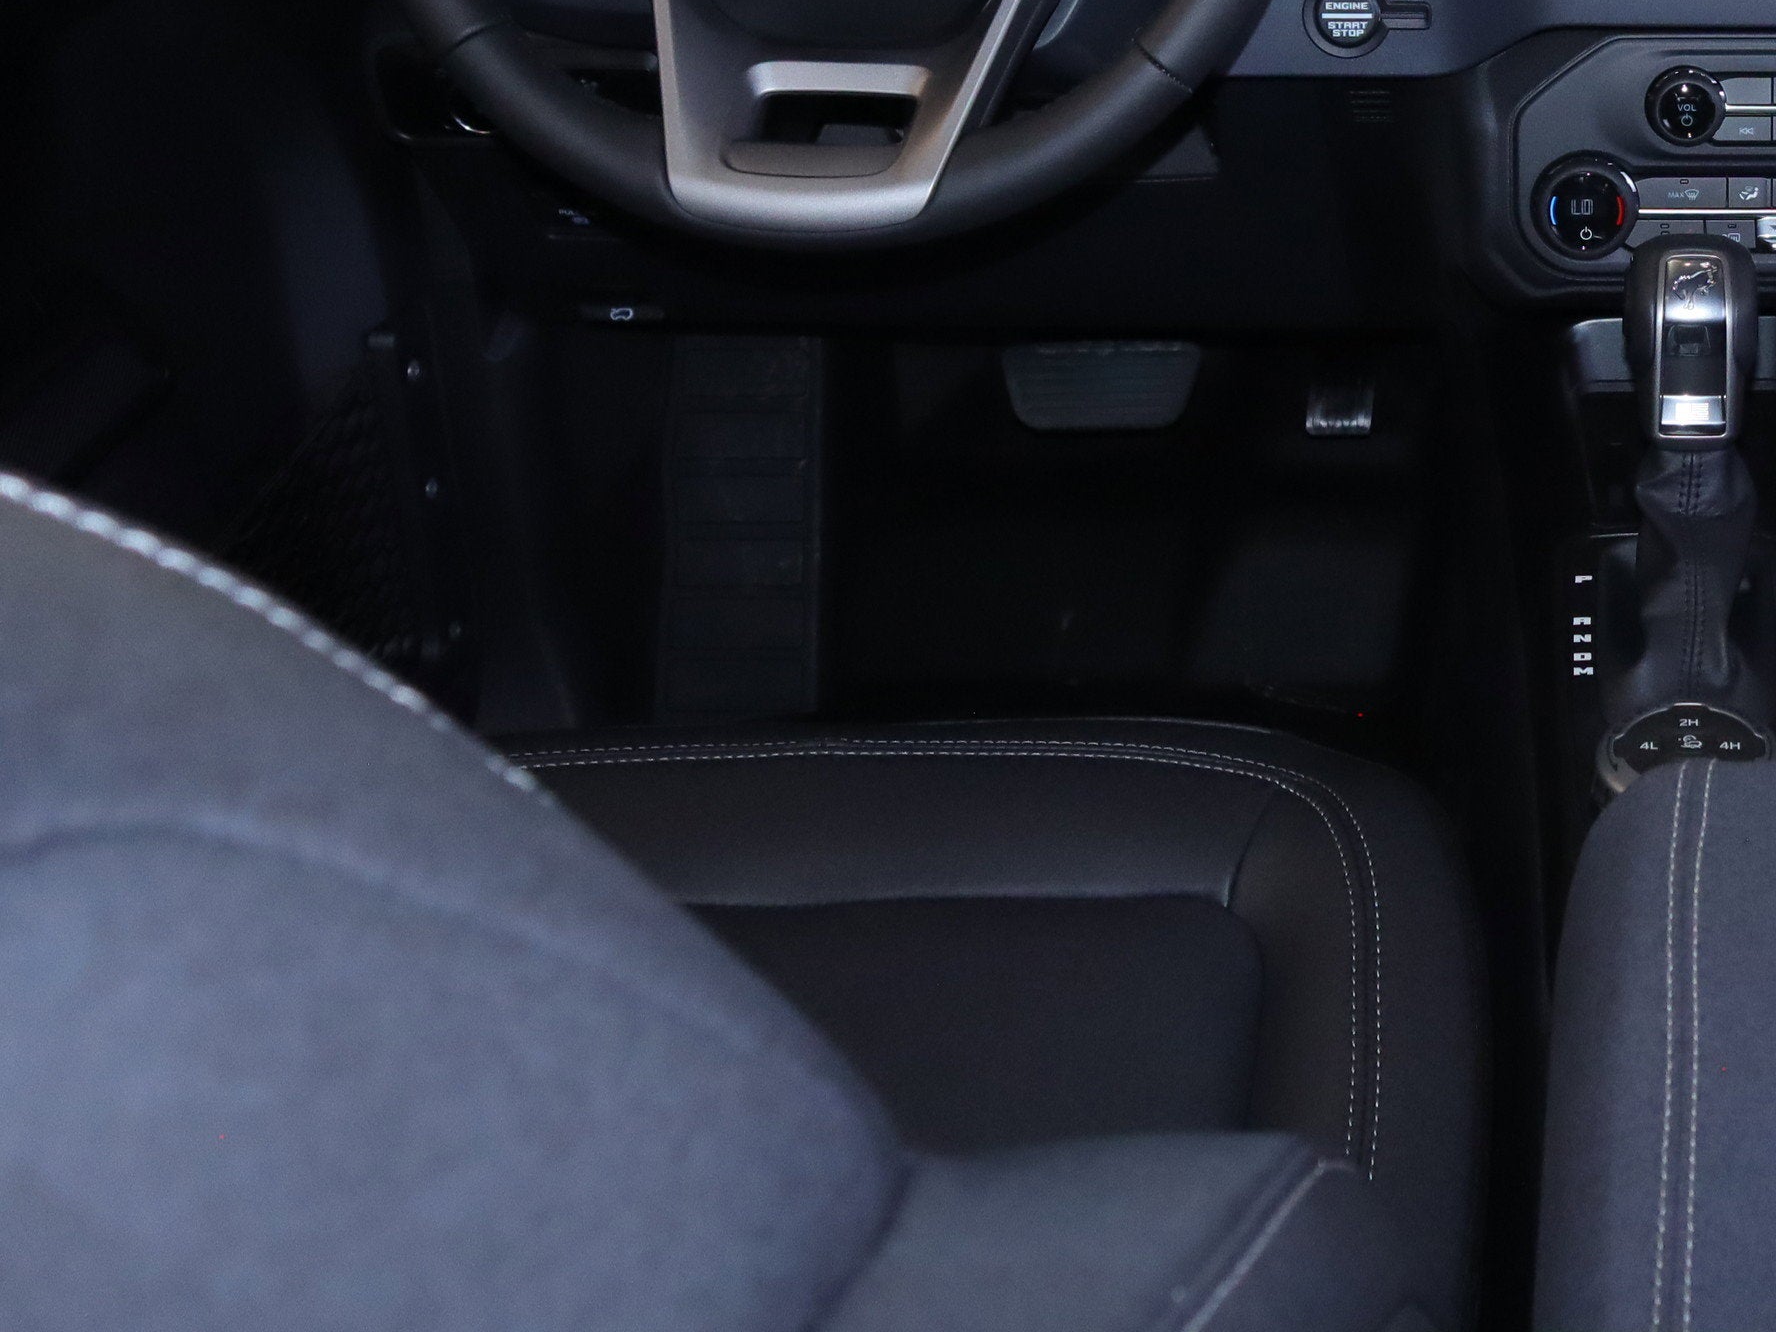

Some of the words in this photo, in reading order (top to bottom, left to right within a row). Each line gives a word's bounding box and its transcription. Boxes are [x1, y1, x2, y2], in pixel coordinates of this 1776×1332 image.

[1325, 1, 1369, 10] ENGINE
[1327, 21, 1369, 30] START
[1332, 29, 1365, 38] STOP
[1677, 103, 1697, 112] VOL
[1667, 191, 1685, 199] MAX
[1574, 574, 1593, 584] P
[1573, 633, 1592, 643] N
[1573, 652, 1592, 661] D
[1573, 666, 1594, 676] M
[1679, 718, 1699, 727] 2H
[1639, 742, 1659, 750] 4L
[1719, 741, 1741, 750] 4H
